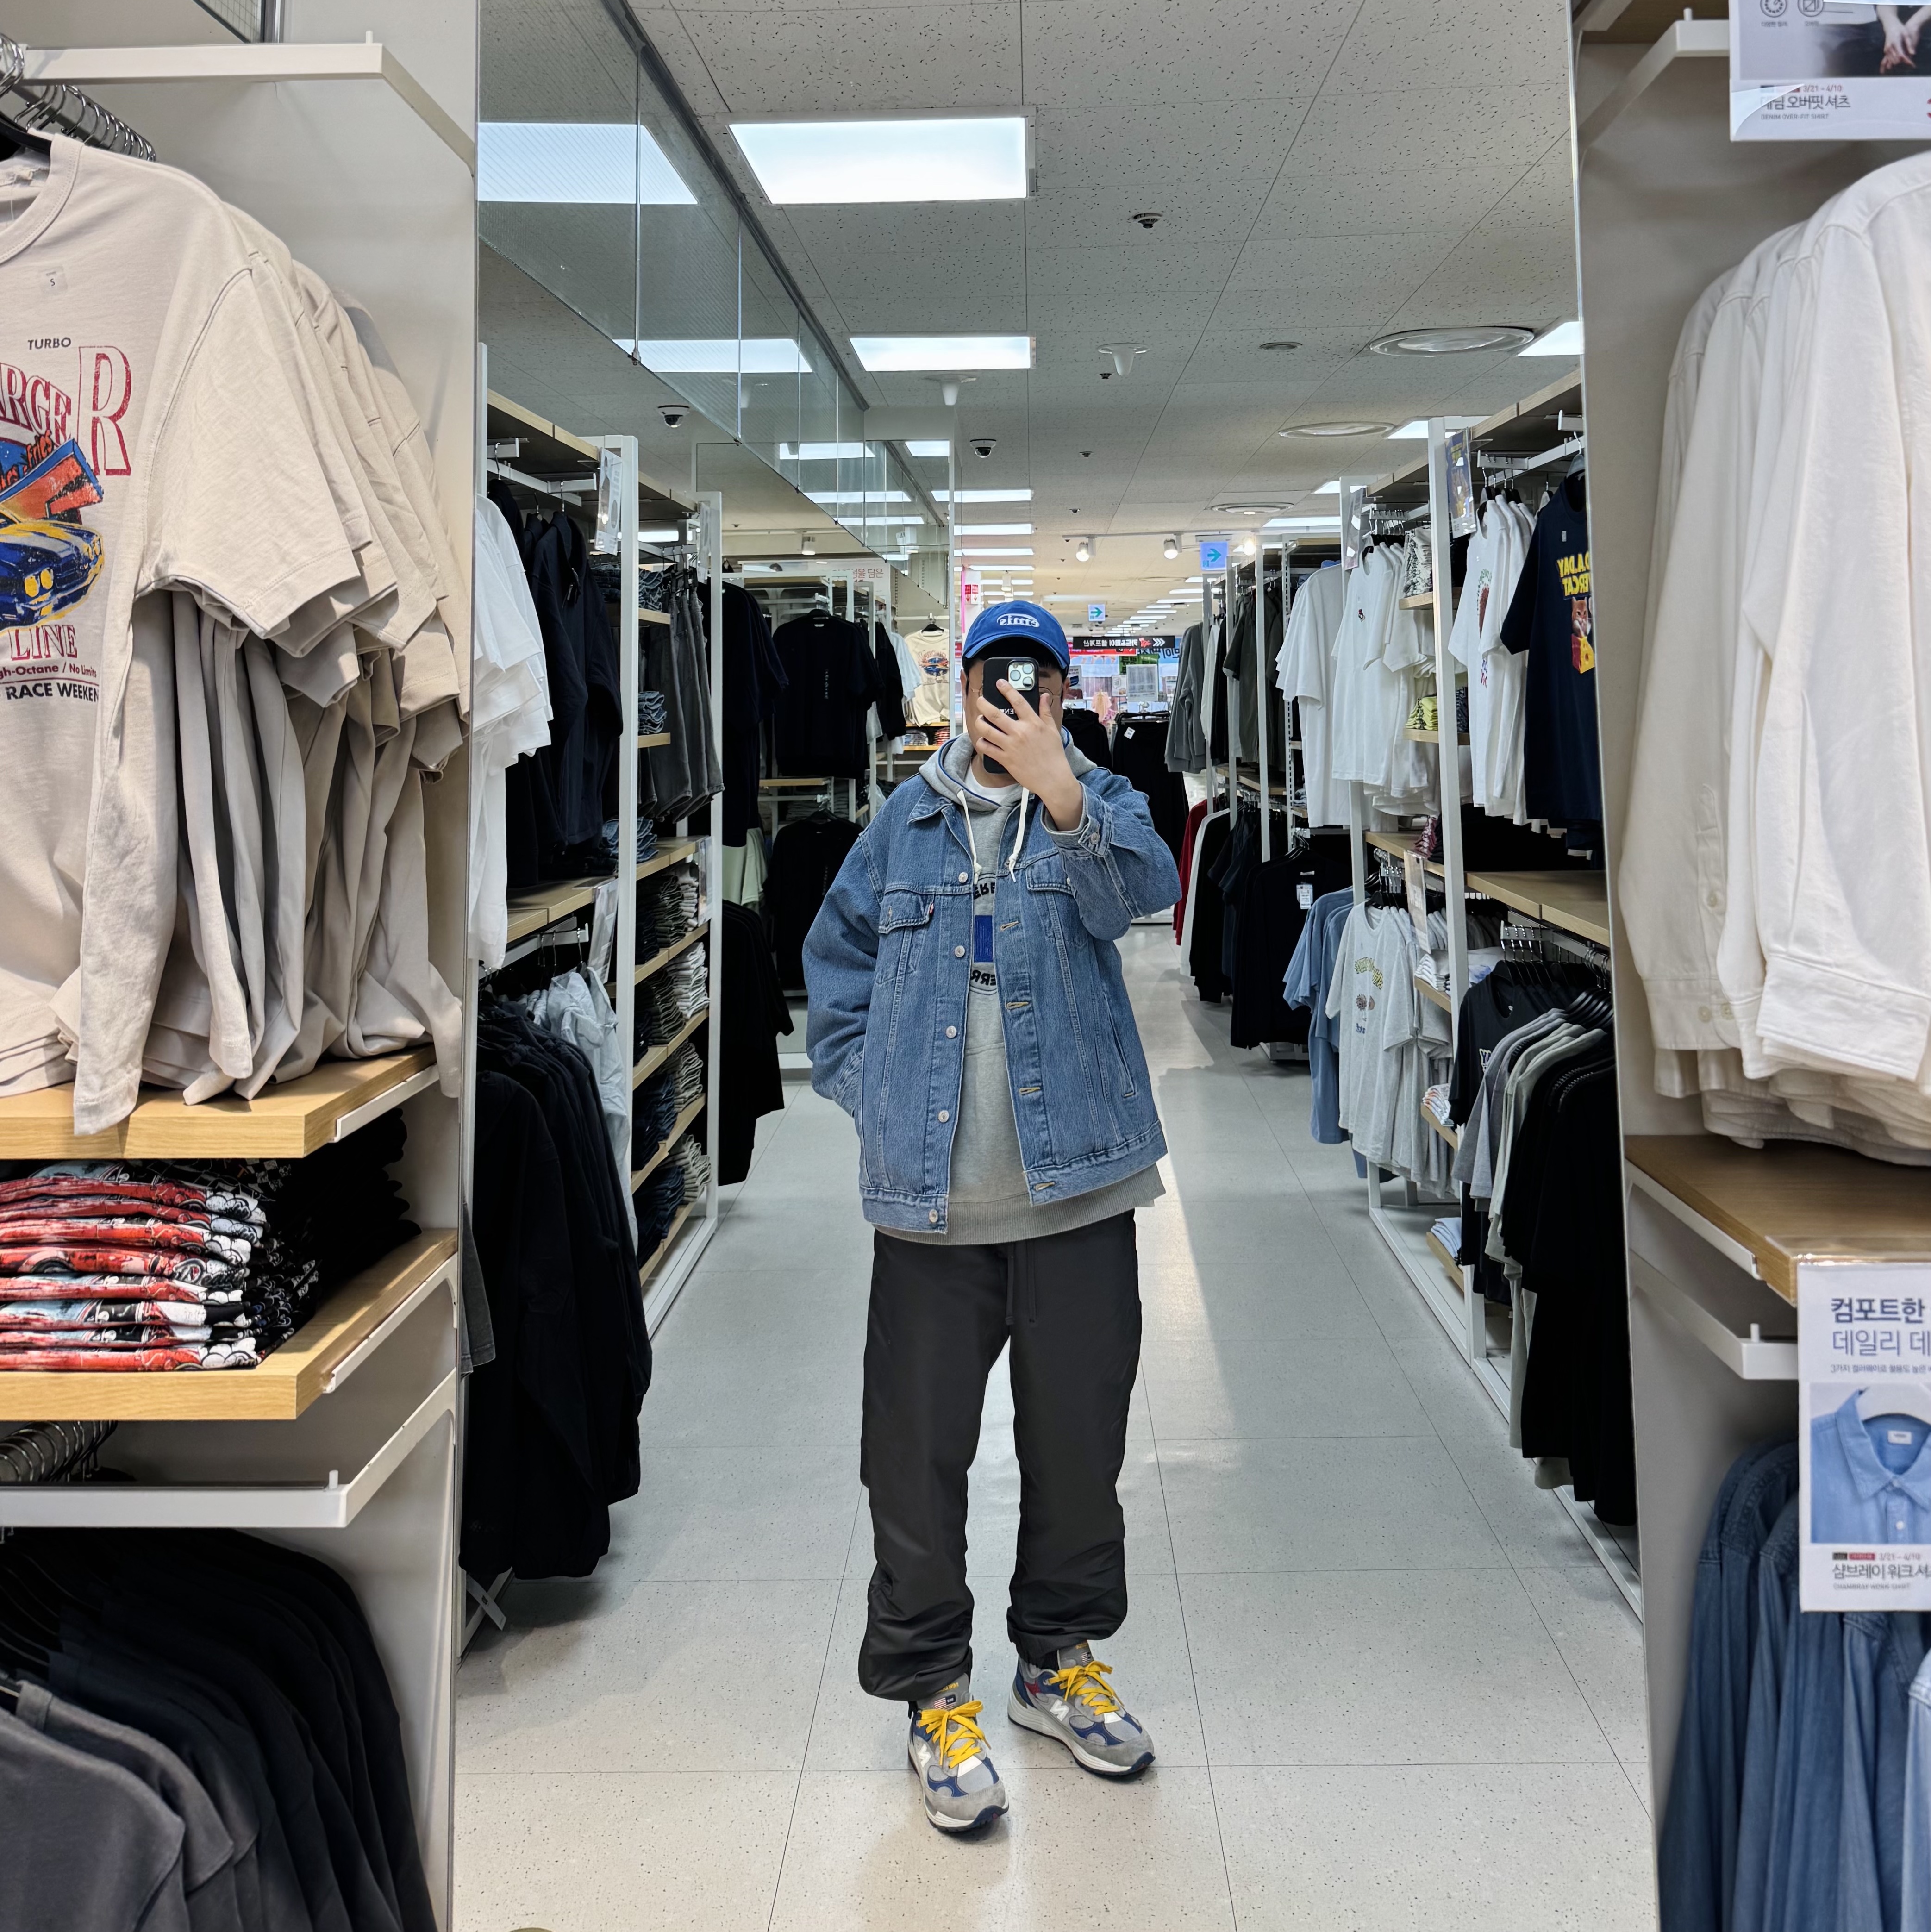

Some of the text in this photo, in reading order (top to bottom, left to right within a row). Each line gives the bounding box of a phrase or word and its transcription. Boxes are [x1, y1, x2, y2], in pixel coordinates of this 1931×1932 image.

[1787, 95, 1823, 110] 오버핏
[1825, 95, 1851, 110] 셔츠
[28, 337, 71, 350] TURBO
[868, 568, 884, 578] 담은
[8, 625, 77, 661] LINE
[69, 663, 80, 674] No
[81, 665, 97, 678] Limits
[6, 682, 53, 700] RACE
[1831, 1298, 1925, 1324] 컴포트한
[1833, 1330, 1900, 1357] 데일리
[1832, 1563, 1931, 1579] 샴브레이 워크 셔
